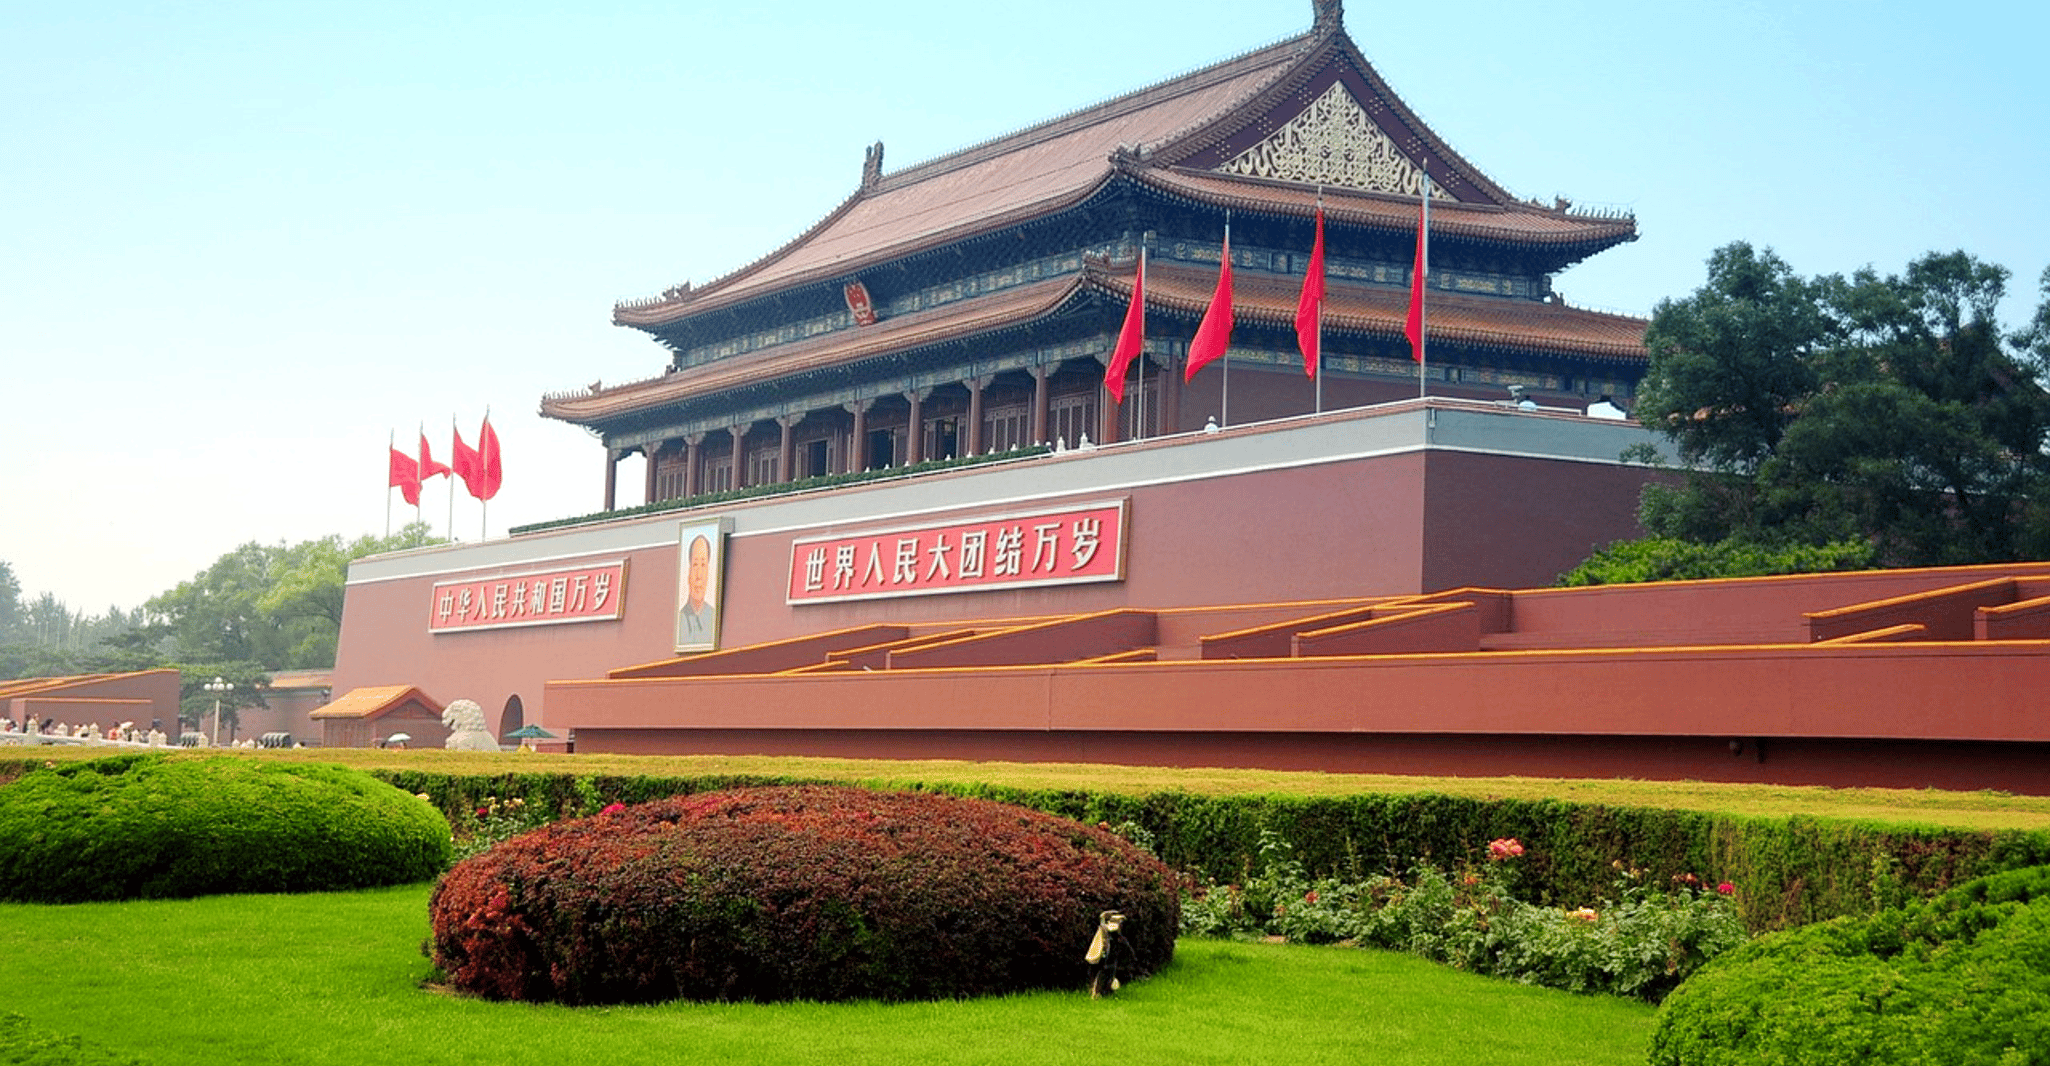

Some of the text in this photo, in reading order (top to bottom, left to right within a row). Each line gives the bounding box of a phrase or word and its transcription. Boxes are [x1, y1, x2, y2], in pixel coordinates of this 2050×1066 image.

[804, 518, 1101, 592] 世界人民大团结万岁
[439, 572, 612, 623] 中华人民共和国万岁
